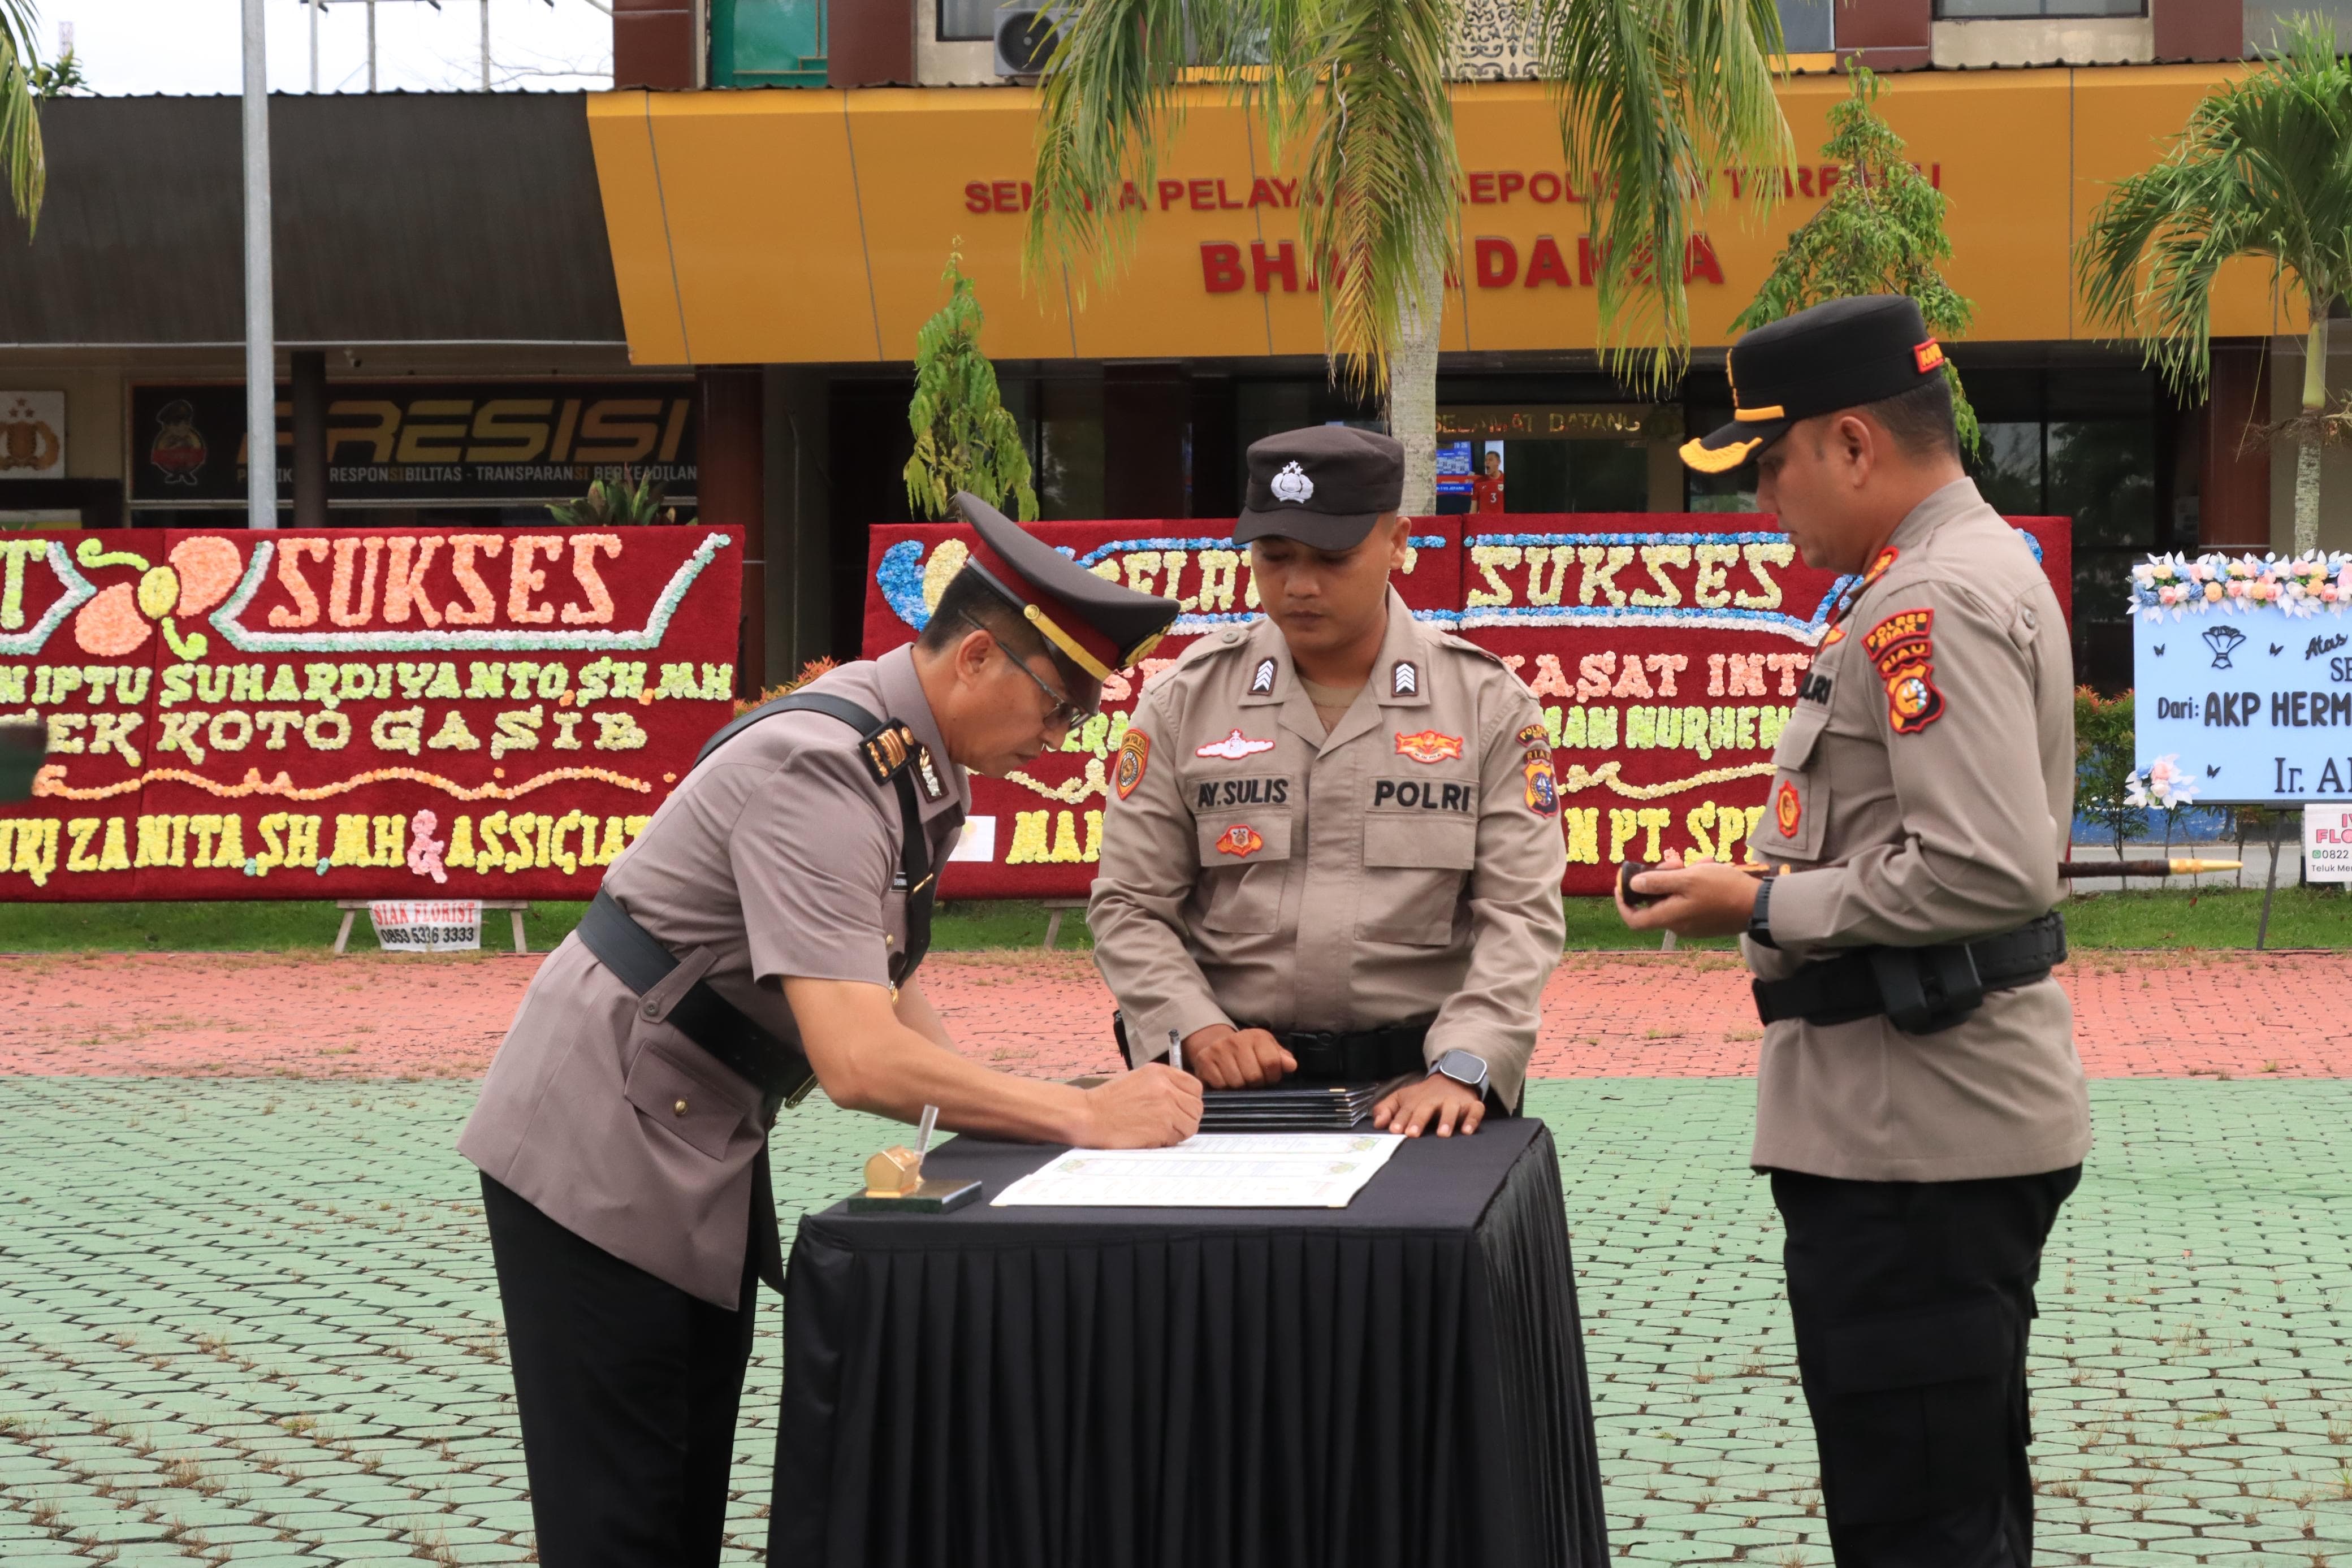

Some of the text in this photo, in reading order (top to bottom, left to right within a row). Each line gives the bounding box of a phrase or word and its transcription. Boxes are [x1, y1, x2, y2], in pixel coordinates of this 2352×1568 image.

[330, 466, 462, 482] RESPONSIBILITAS
[476, 466, 589, 482] TRANSPARANSI
[1490, 492, 1497, 503] 3
[268, 533, 622, 628] SUKSES
[1466, 543, 1796, 609] SUKSES
[1867, 613, 1927, 648] POLRES
[2305, 633, 2348, 660] Atas
[1882, 643, 1926, 672] RIAU
[1502, 651, 1815, 703] ASAT INT
[2158, 696, 2199, 719] Dari:
[2204, 691, 2260, 727] AKP
[157, 709, 351, 765] KOTO
[371, 704, 648, 760] GASIB
[2275, 757, 2305, 793] Ir.
[1197, 778, 1289, 807] AY.SULIS
[1374, 780, 1470, 812] POLRI
[407, 809, 448, 883] &
[2322, 850, 2349, 859] 0822
[373, 902, 474, 925] SIAK FLORIST
[381, 928, 410, 944] 0853
[442, 926, 474, 942] 3333
